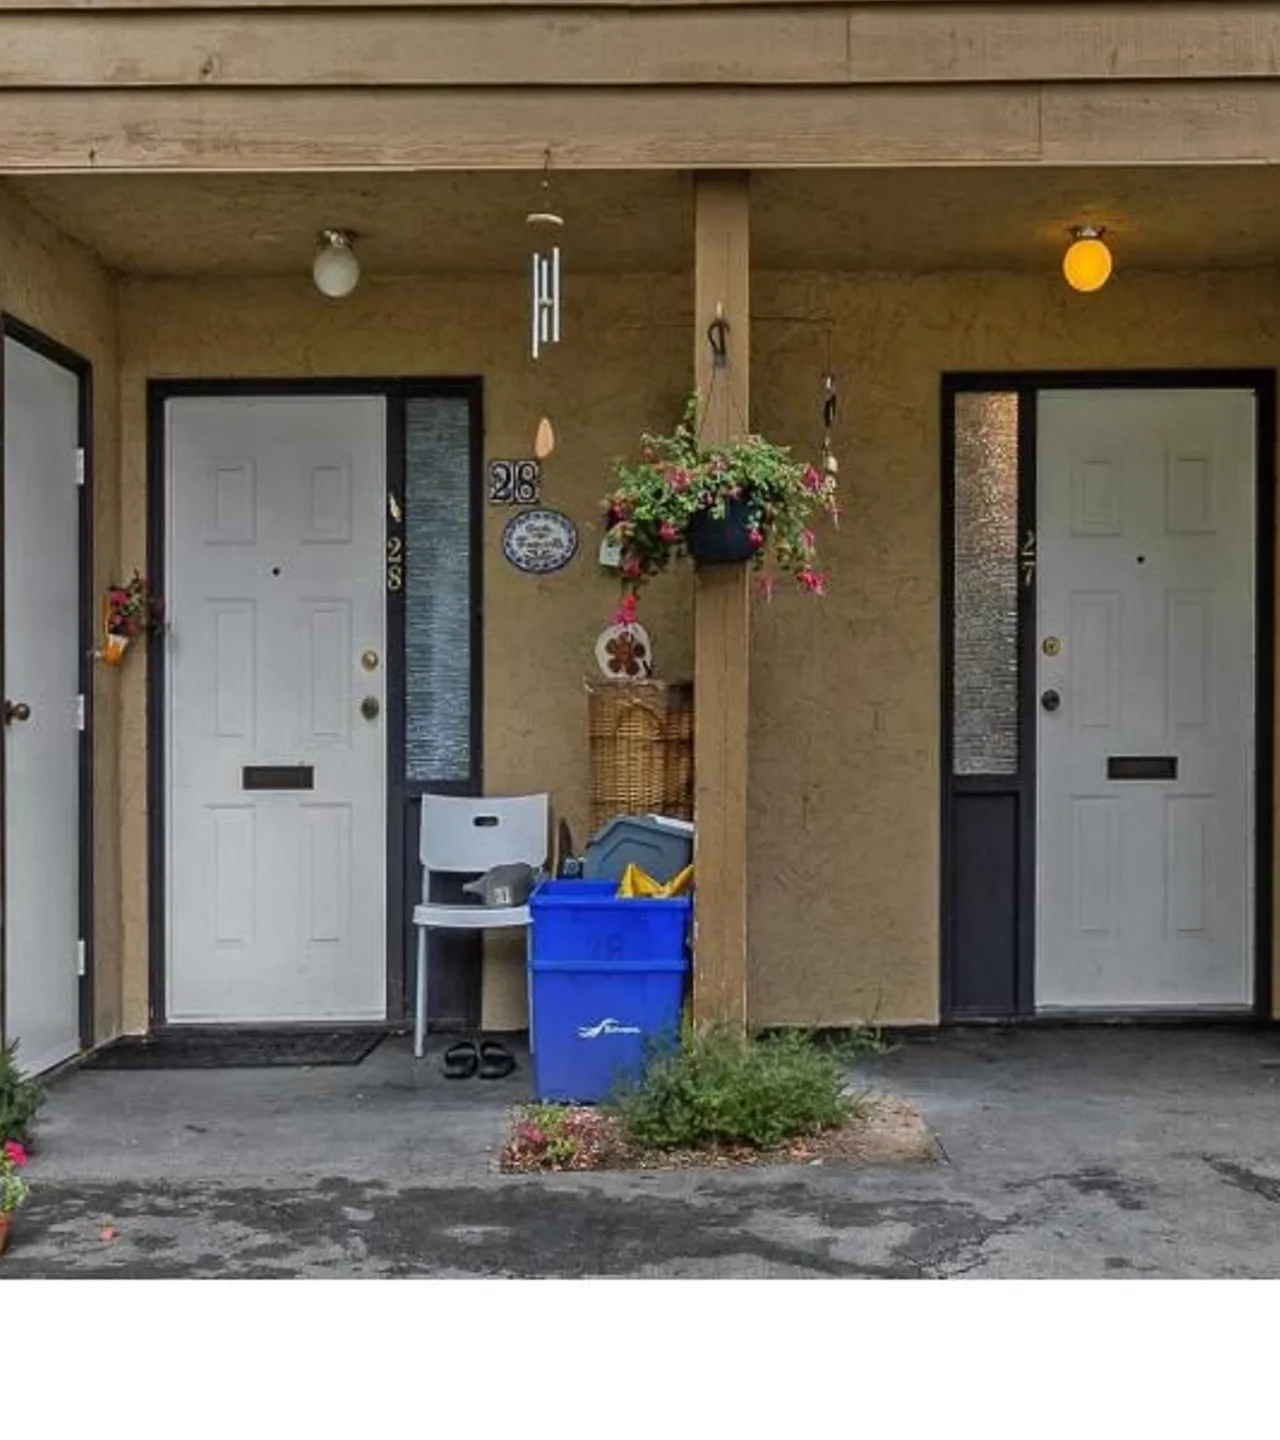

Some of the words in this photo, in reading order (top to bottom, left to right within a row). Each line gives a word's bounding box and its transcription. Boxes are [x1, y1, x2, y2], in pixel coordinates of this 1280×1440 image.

[489, 462, 536, 501] 28
[388, 537, 402, 590] 28
[1021, 530, 1035, 587] 27
